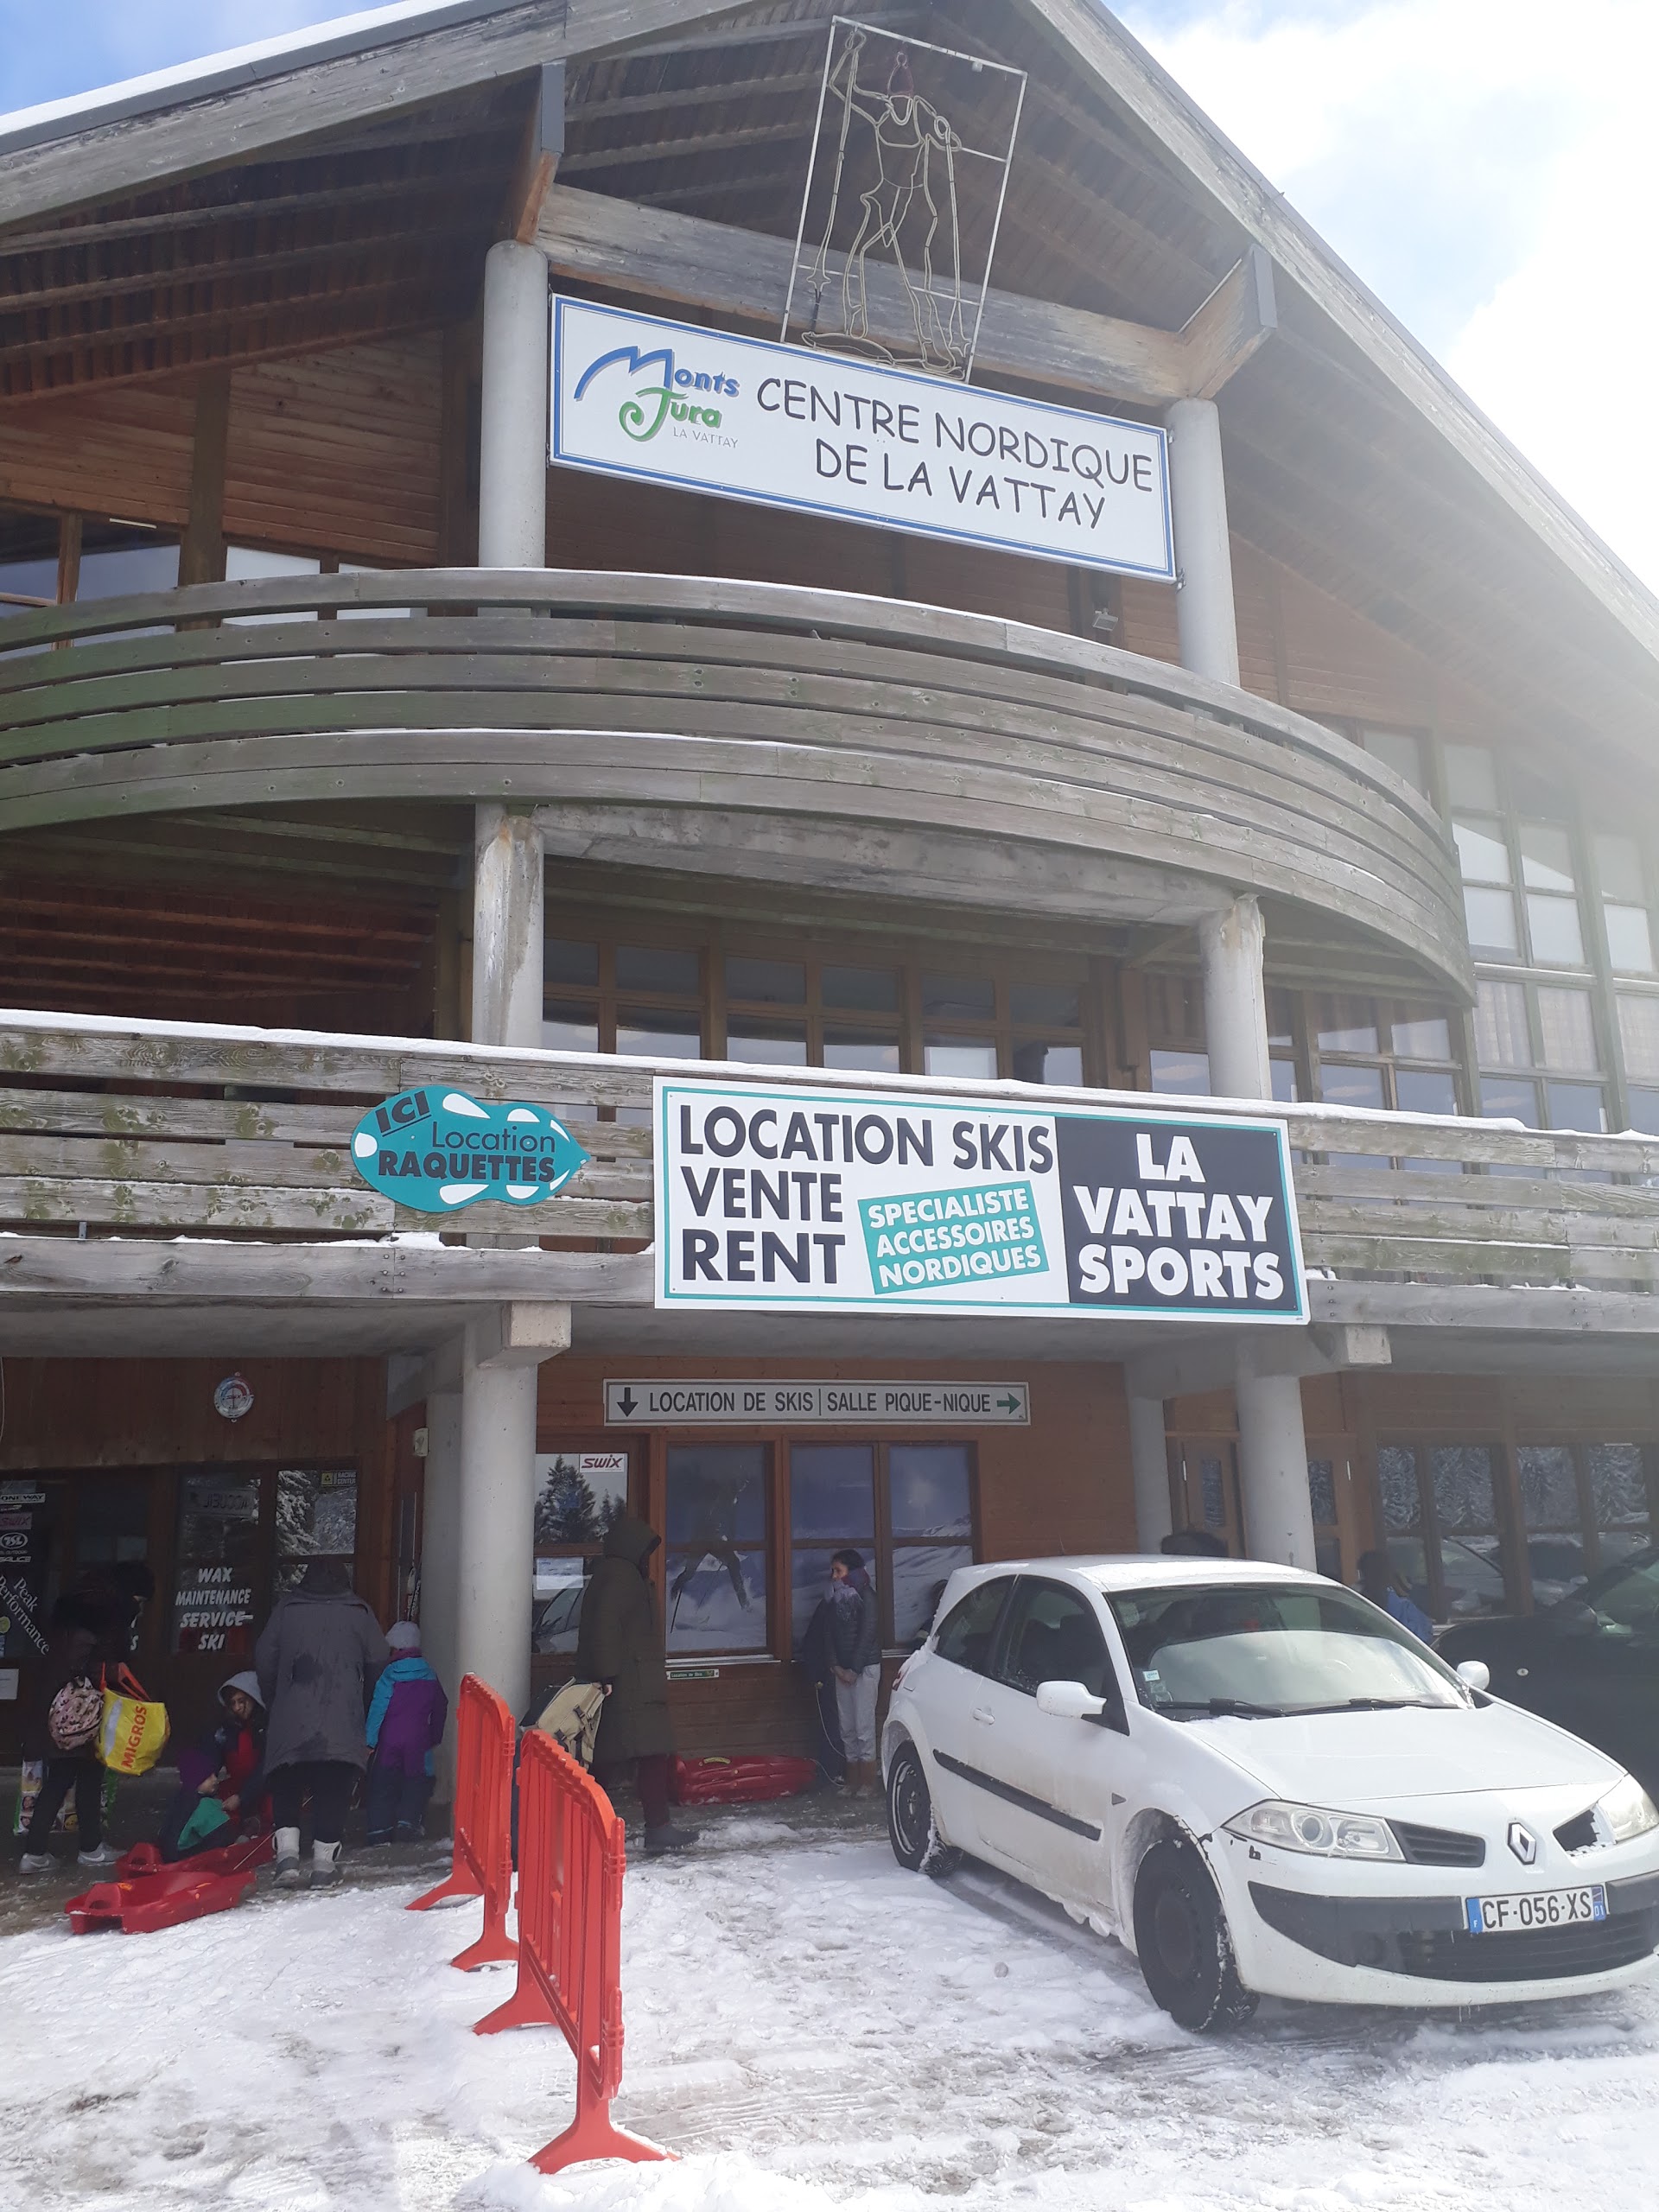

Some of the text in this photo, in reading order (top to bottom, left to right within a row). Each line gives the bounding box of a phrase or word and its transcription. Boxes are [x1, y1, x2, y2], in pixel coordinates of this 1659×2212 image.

[574, 346, 741, 401] Monts
[619, 387, 722, 442] Jura
[757, 378, 1153, 492] CENTRE NORDIQUE
[673, 427, 739, 448] LA VATTAY
[817, 439, 1105, 529] DE LA VATTAY
[375, 1090, 429, 1133] ICI
[432, 1122, 556, 1153] Location
[680, 1105, 1053, 1174] LOCATION SKIS
[1135, 1133, 1206, 1183] LA
[378, 1150, 556, 1183] RAQUETTES
[681, 1166, 843, 1223] VENTE
[868, 1188, 1028, 1230] SPECIALISTE
[1073, 1185, 1274, 1242] VATTAY
[682, 1230, 846, 1284] RENT
[876, 1216, 1034, 1258] ACCESSOIRES
[879, 1245, 1041, 1288] NORDIQUES
[1078, 1243, 1284, 1300] SPORTS
[650, 1391, 813, 1412] LOCATION DE SKIS
[827, 1392, 990, 1413] SALLE PIQUE-NIQUE
[14, 1576, 38, 1612] Peak
[198, 1567, 233, 1583] WAX
[175, 1588, 251, 1605] MAINTENANCE
[180, 1611, 245, 1629] SERVICE
[198, 1633, 225, 1650] SKI
[121, 1705, 147, 1769] MIGROS
[1472, 1919, 1478, 1929] F
